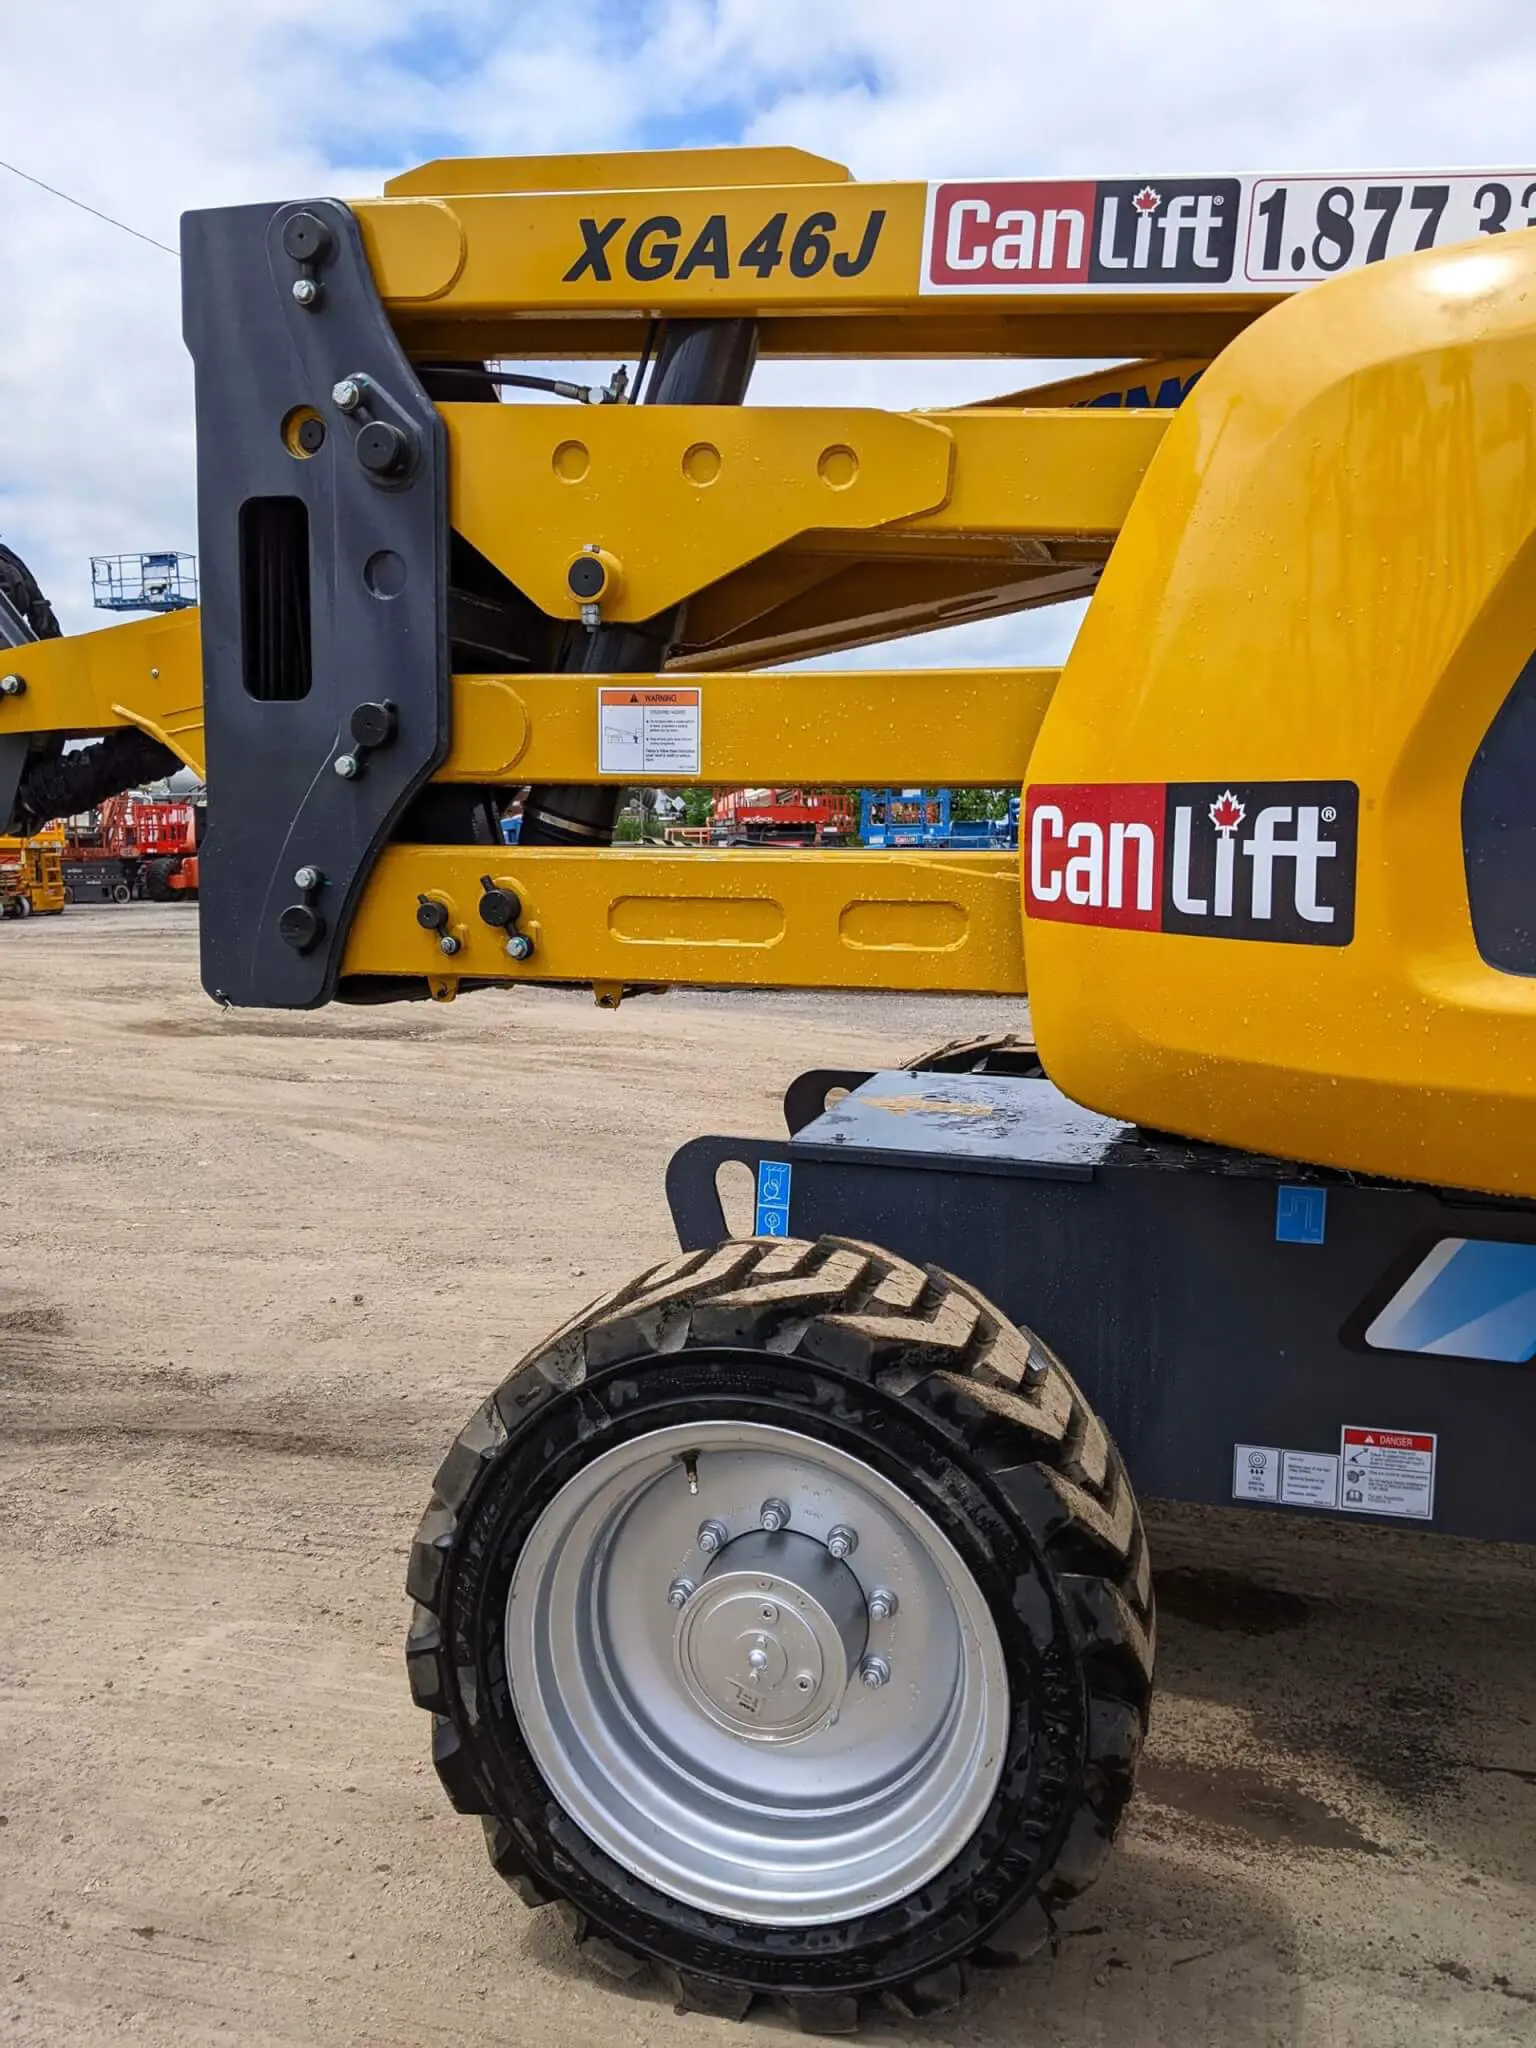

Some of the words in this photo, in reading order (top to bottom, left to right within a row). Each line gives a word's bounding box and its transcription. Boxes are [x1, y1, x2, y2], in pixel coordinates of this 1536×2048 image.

[562, 210, 886, 282] XGA46J
[644, 694, 677, 702] WARNING
[1379, 1435, 1413, 1448] DANGER
